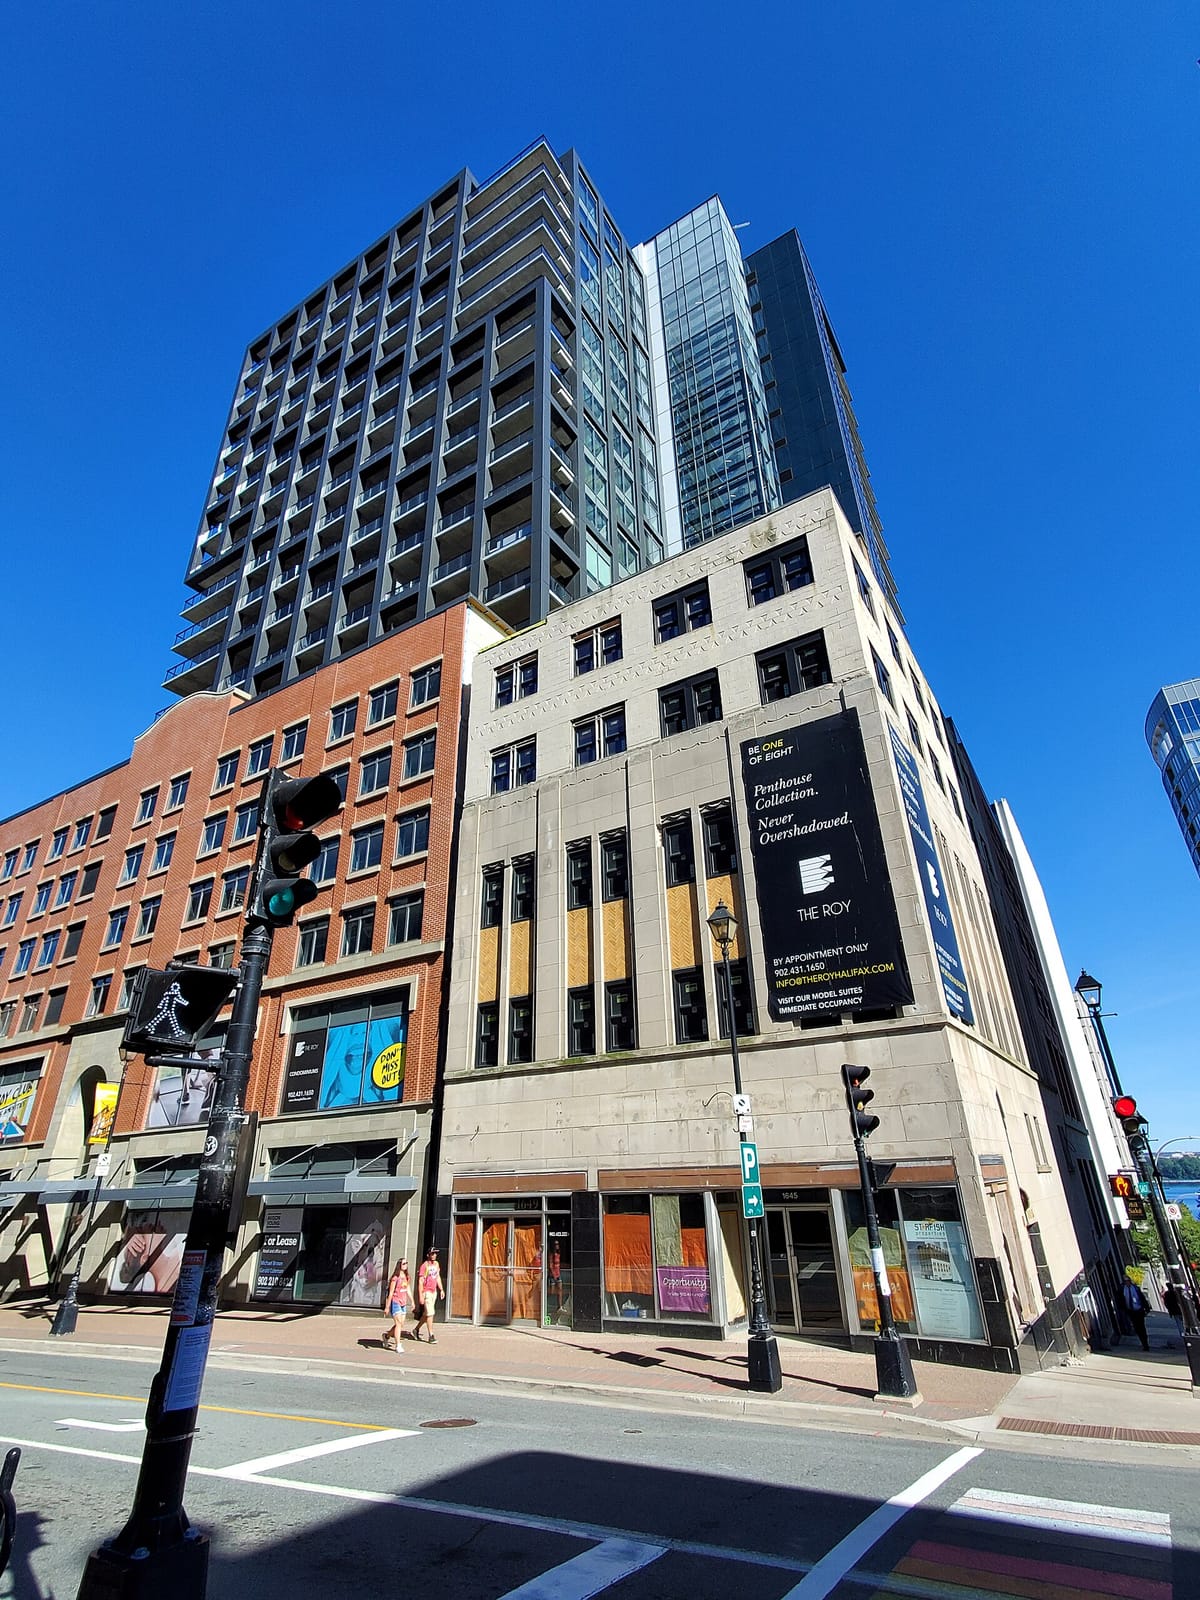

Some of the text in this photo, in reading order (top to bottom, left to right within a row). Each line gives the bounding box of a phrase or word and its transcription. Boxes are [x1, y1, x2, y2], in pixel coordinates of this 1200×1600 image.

[748, 738, 784, 756] BE ONE
[749, 745, 794, 766] OF EIGHT
[754, 773, 813, 797] Penthouse
[755, 787, 819, 811] Collection.
[758, 813, 794, 831] Never
[759, 811, 853, 845] Overshadowed.
[796, 899, 851, 922] THE ROY
[773, 942, 869, 967] BY APPOINTMENT ONLY
[774, 962, 825, 978] 902.431.1650
[775, 962, 895, 989] INFO@THEROYHALIFAX.COM
[777, 986, 863, 1005] VISIT OUR MODEL SUITES
[778, 996, 863, 1014] IMMEDIATE OCCUPANCY
[381, 1058, 399, 1074] MISS
[381, 1069, 401, 1085] OUT!
[742, 1147, 756, 1179] P
[782, 1191, 799, 1200] 1645
[263, 1234, 298, 1246] For Lease
[662, 1277, 707, 1292] Opportunity
